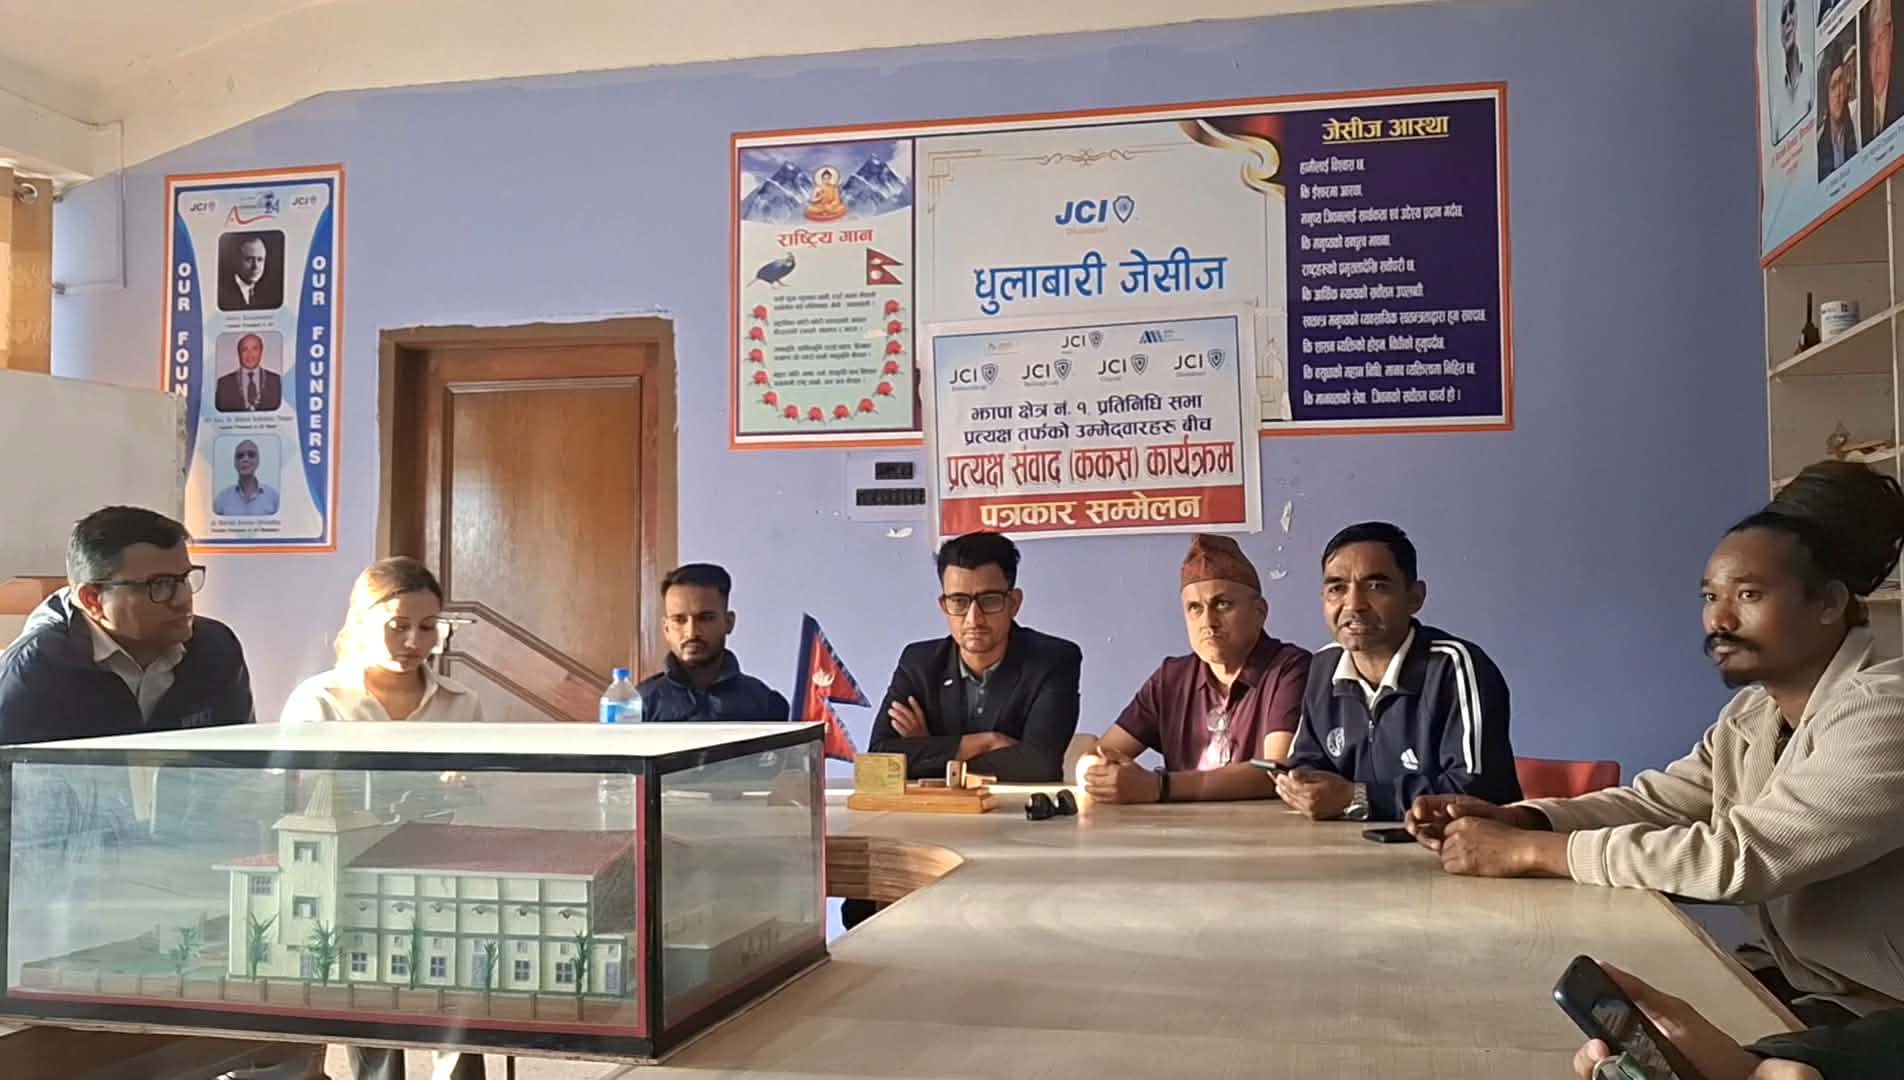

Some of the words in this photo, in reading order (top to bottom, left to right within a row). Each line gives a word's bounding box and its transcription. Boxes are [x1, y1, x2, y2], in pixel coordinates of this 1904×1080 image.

[1322, 116, 1383, 141] जेसीज
[1389, 116, 1449, 137] आस्था
[1055, 200, 1108, 225] JCI
[839, 229, 873, 242] गान
[178, 262, 192, 311] OUR
[312, 256, 326, 305] OUR
[973, 251, 1107, 315] धुलाबारी
[1119, 246, 1228, 294] जेसीज
[1062, 334, 1086, 349] JCI
[176, 331, 189, 400] FOUN
[950, 367, 977, 385] JCI
[1022, 363, 1050, 380] JCI
[1099, 358, 1127, 375] JCI
[1174, 353, 1203, 371] JCI
[309, 326, 325, 465] FOUNDERS
[971, 406, 1013, 421] झापा
[1019, 400, 1048, 420] क्षेत्र
[1097, 393, 1162, 416] प्रतिनिधि
[1167, 394, 1202, 411] सभा
[964, 429, 1012, 446] प्रत्यक्ष
[1018, 421, 1069, 441] तर्फको
[1182, 414, 1212, 432] बीच
[947, 453, 1004, 491] प्रत्यक्ष
[1011, 445, 1062, 485] संवाद
[1070, 446, 1139, 482] (ककस)
[1146, 434, 1234, 478] कार्यक्रम
[980, 501, 1078, 528] पत्रकार
[1085, 491, 1202, 525] सम्मेलन
